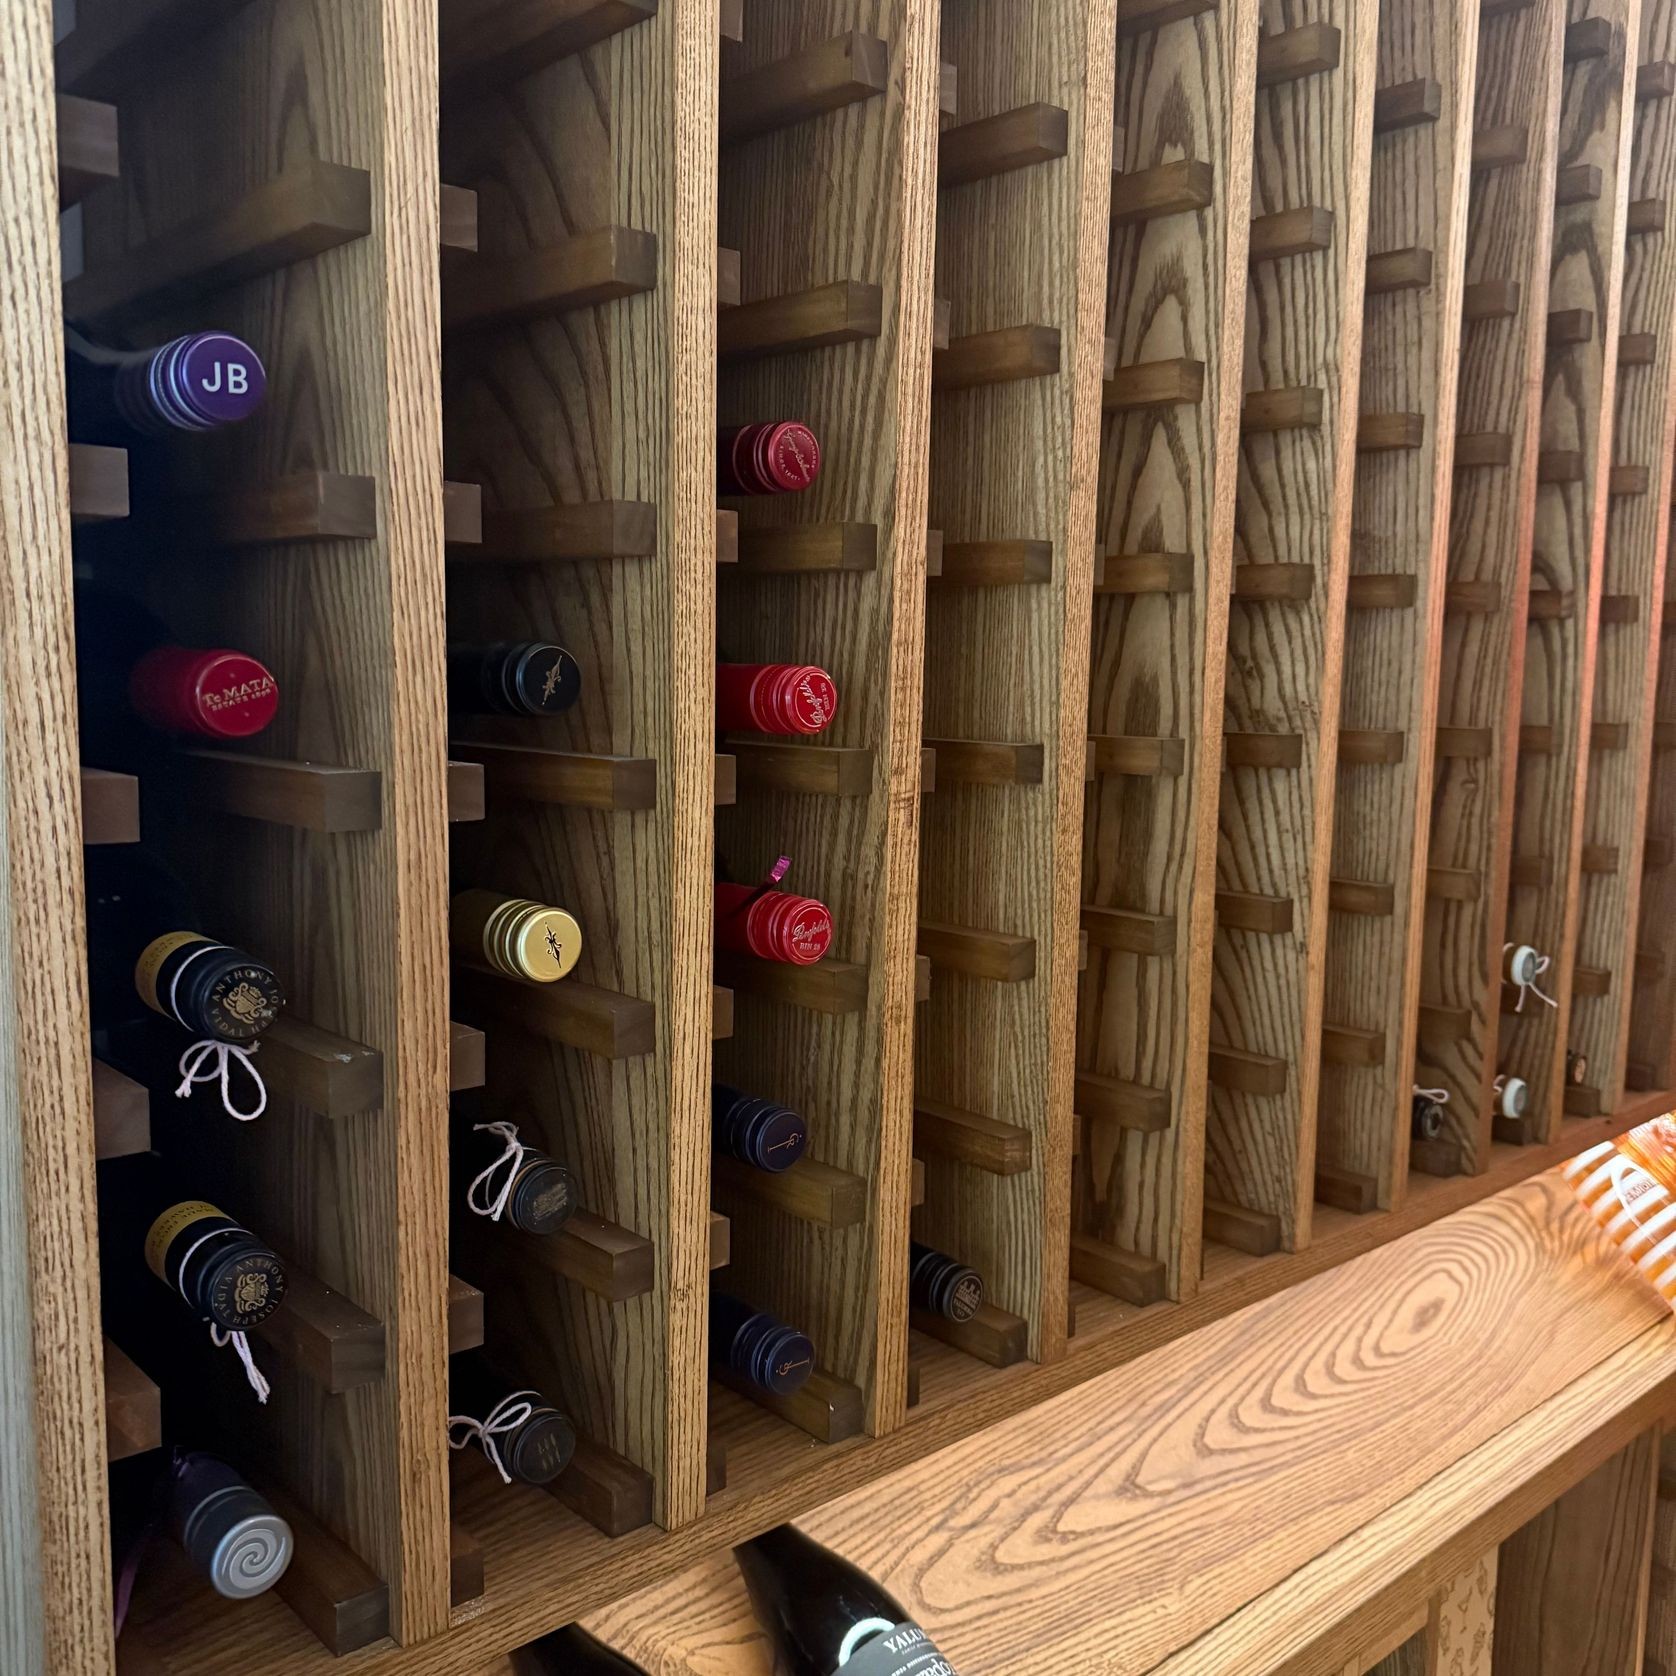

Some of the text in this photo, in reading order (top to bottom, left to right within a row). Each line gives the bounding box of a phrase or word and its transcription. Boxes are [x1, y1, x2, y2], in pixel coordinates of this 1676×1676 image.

[202, 361, 248, 395] JB
[202, 677, 273, 708] Te MATA
[212, 969, 272, 1002] ANTHONY
[211, 1008, 244, 1036] VIDAL
[236, 1260, 284, 1292] ANTHONY
[232, 1299, 280, 1325] JOSEPH
